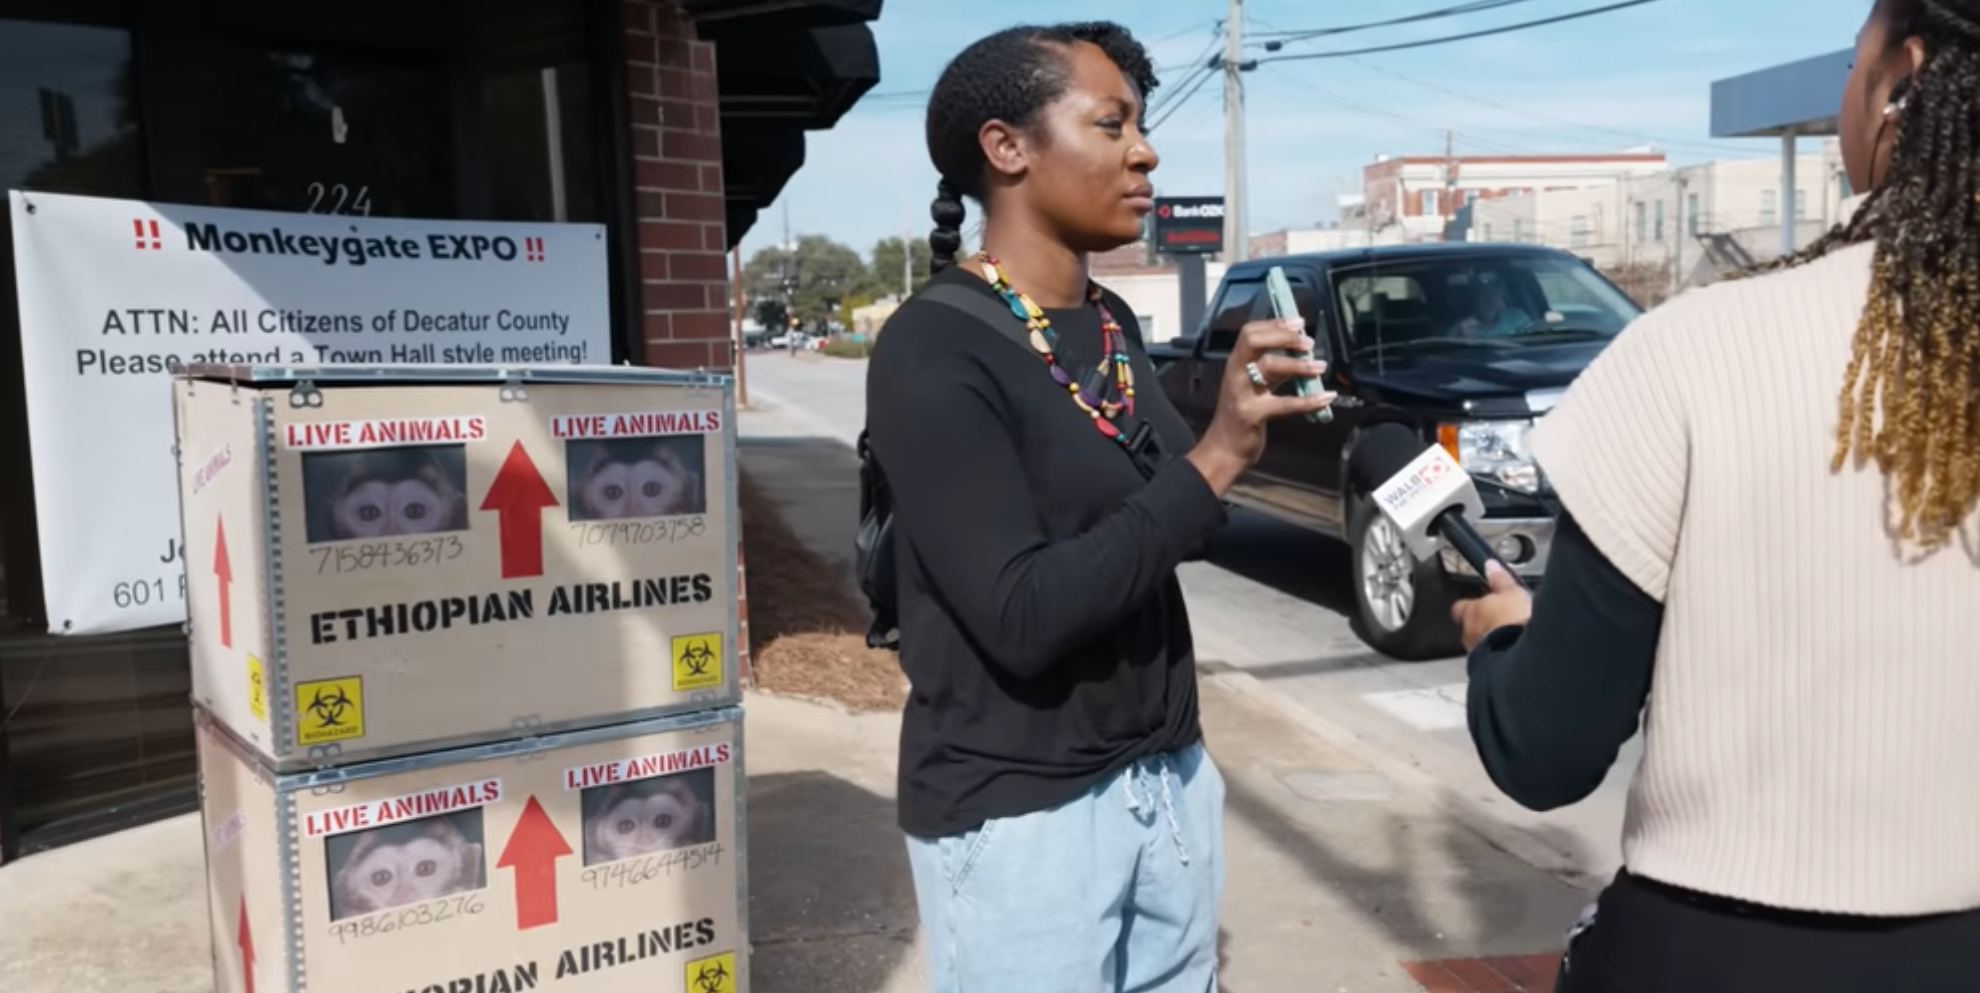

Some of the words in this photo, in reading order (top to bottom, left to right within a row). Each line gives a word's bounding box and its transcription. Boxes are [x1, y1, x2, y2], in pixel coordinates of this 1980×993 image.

[307, 182, 372, 217] 224
[184, 221, 421, 265] Monkeygate
[427, 234, 517, 261] EXPO
[102, 309, 199, 335] ATTN:
[210, 309, 248, 334] All
[257, 309, 363, 334] Citizens
[371, 309, 396, 333] of
[404, 309, 490, 332] Decatur
[497, 308, 570, 335] County
[76, 349, 181, 375] Please
[192, 346, 280, 363] attend
[314, 344, 383, 363] Town
[391, 343, 435, 363] Hall
[442, 342, 495, 363] style
[501, 340, 588, 364] meeting!
[287, 423, 352, 447] LIVE
[358, 417, 485, 444] ANIMALS
[552, 415, 606, 438] LIVE
[612, 410, 720, 435] ANIMALS
[113, 577, 164, 608] 601
[310, 588, 533, 644] ETHIOPIAN
[547, 573, 713, 616] AIRLINES
[568, 762, 620, 788] LIVE
[626, 743, 729, 779] ANIMALS
[306, 805, 369, 836] LIVE
[376, 780, 499, 822] ANIMALS
[555, 917, 716, 979] AIRLINES
